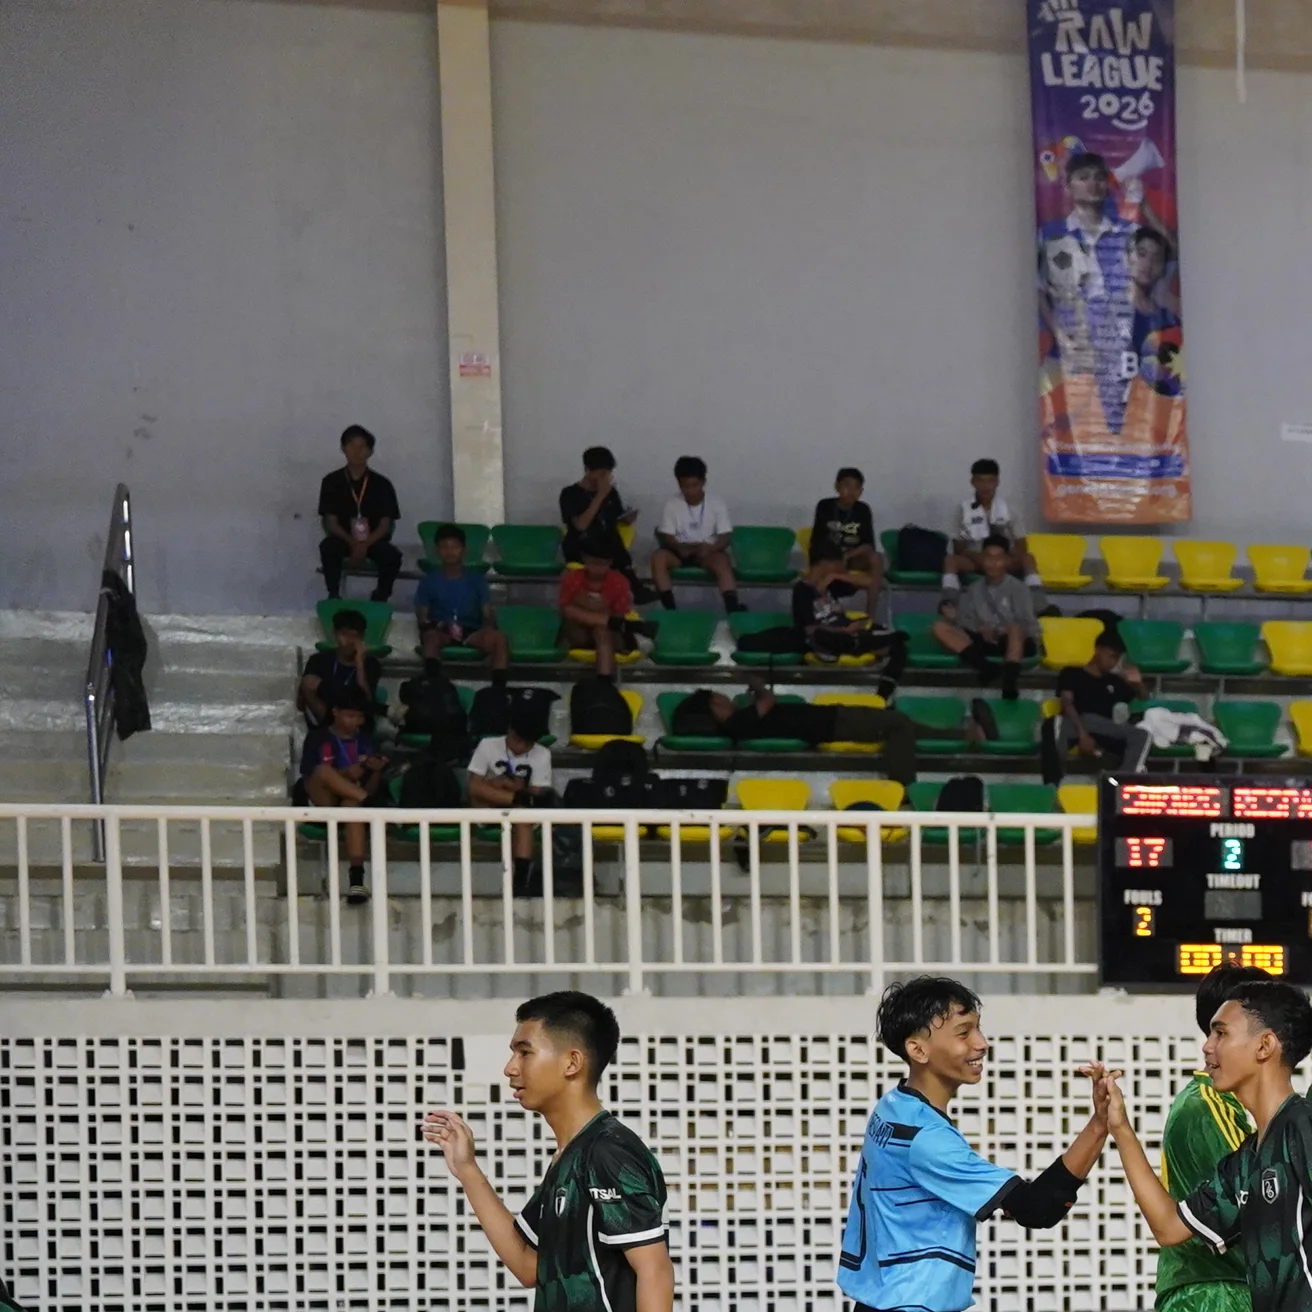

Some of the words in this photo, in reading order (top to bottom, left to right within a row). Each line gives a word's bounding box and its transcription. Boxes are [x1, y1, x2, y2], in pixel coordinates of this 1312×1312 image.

[1053, 8, 1153, 56] RAW
[1041, 52, 1164, 91] LEAGUE
[1080, 91, 1155, 120] 2026
[1210, 823, 1255, 838] PERIOD
[1126, 837, 1166, 867] 17
[1223, 838, 1241, 870] 2
[1206, 873, 1261, 889] TIMEOUT
[1124, 889, 1163, 905] FOULS
[1136, 906, 1152, 936] 2
[1213, 928, 1252, 943] TIMER
